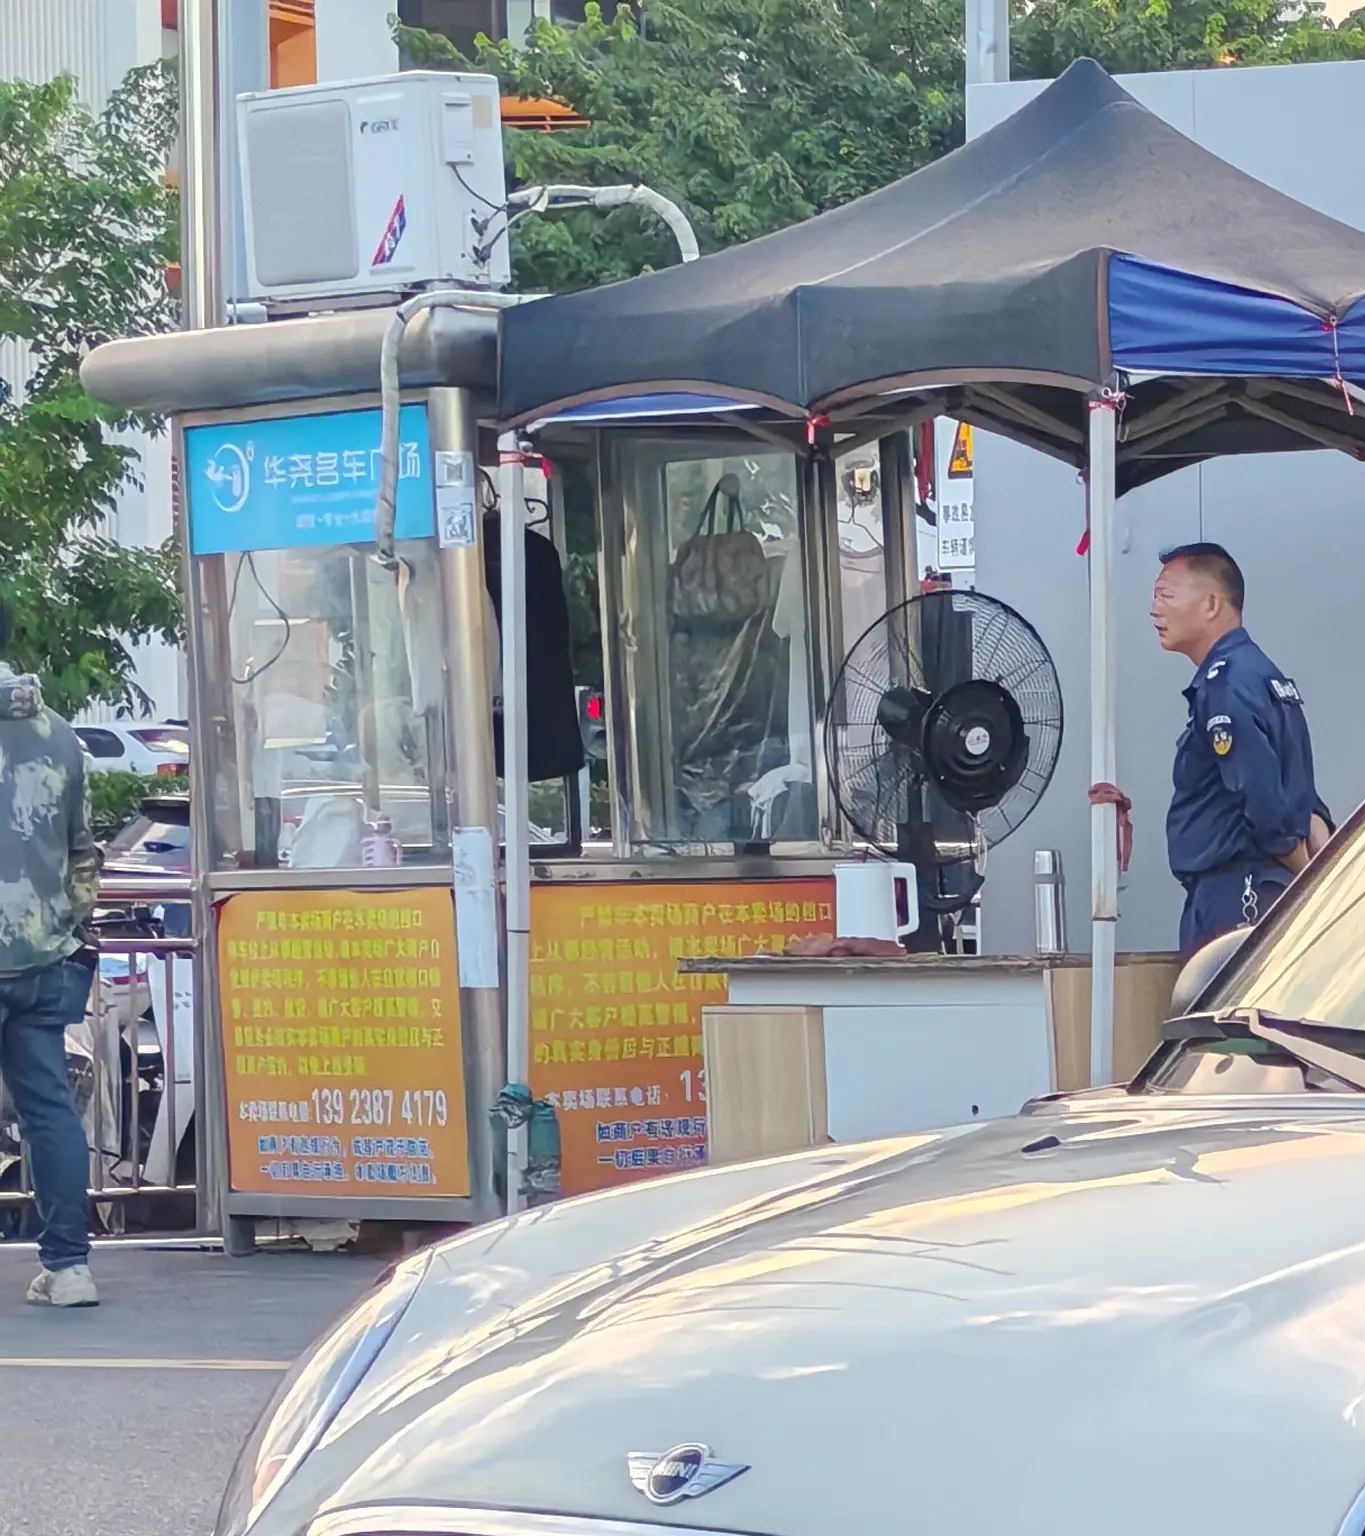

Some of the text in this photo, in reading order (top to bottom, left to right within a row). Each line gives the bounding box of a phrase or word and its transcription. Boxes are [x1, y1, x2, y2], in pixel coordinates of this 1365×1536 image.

[312, 1087, 345, 1125] 139
[349, 1088, 394, 1126] 2387
[401, 1089, 448, 1127] 4179
